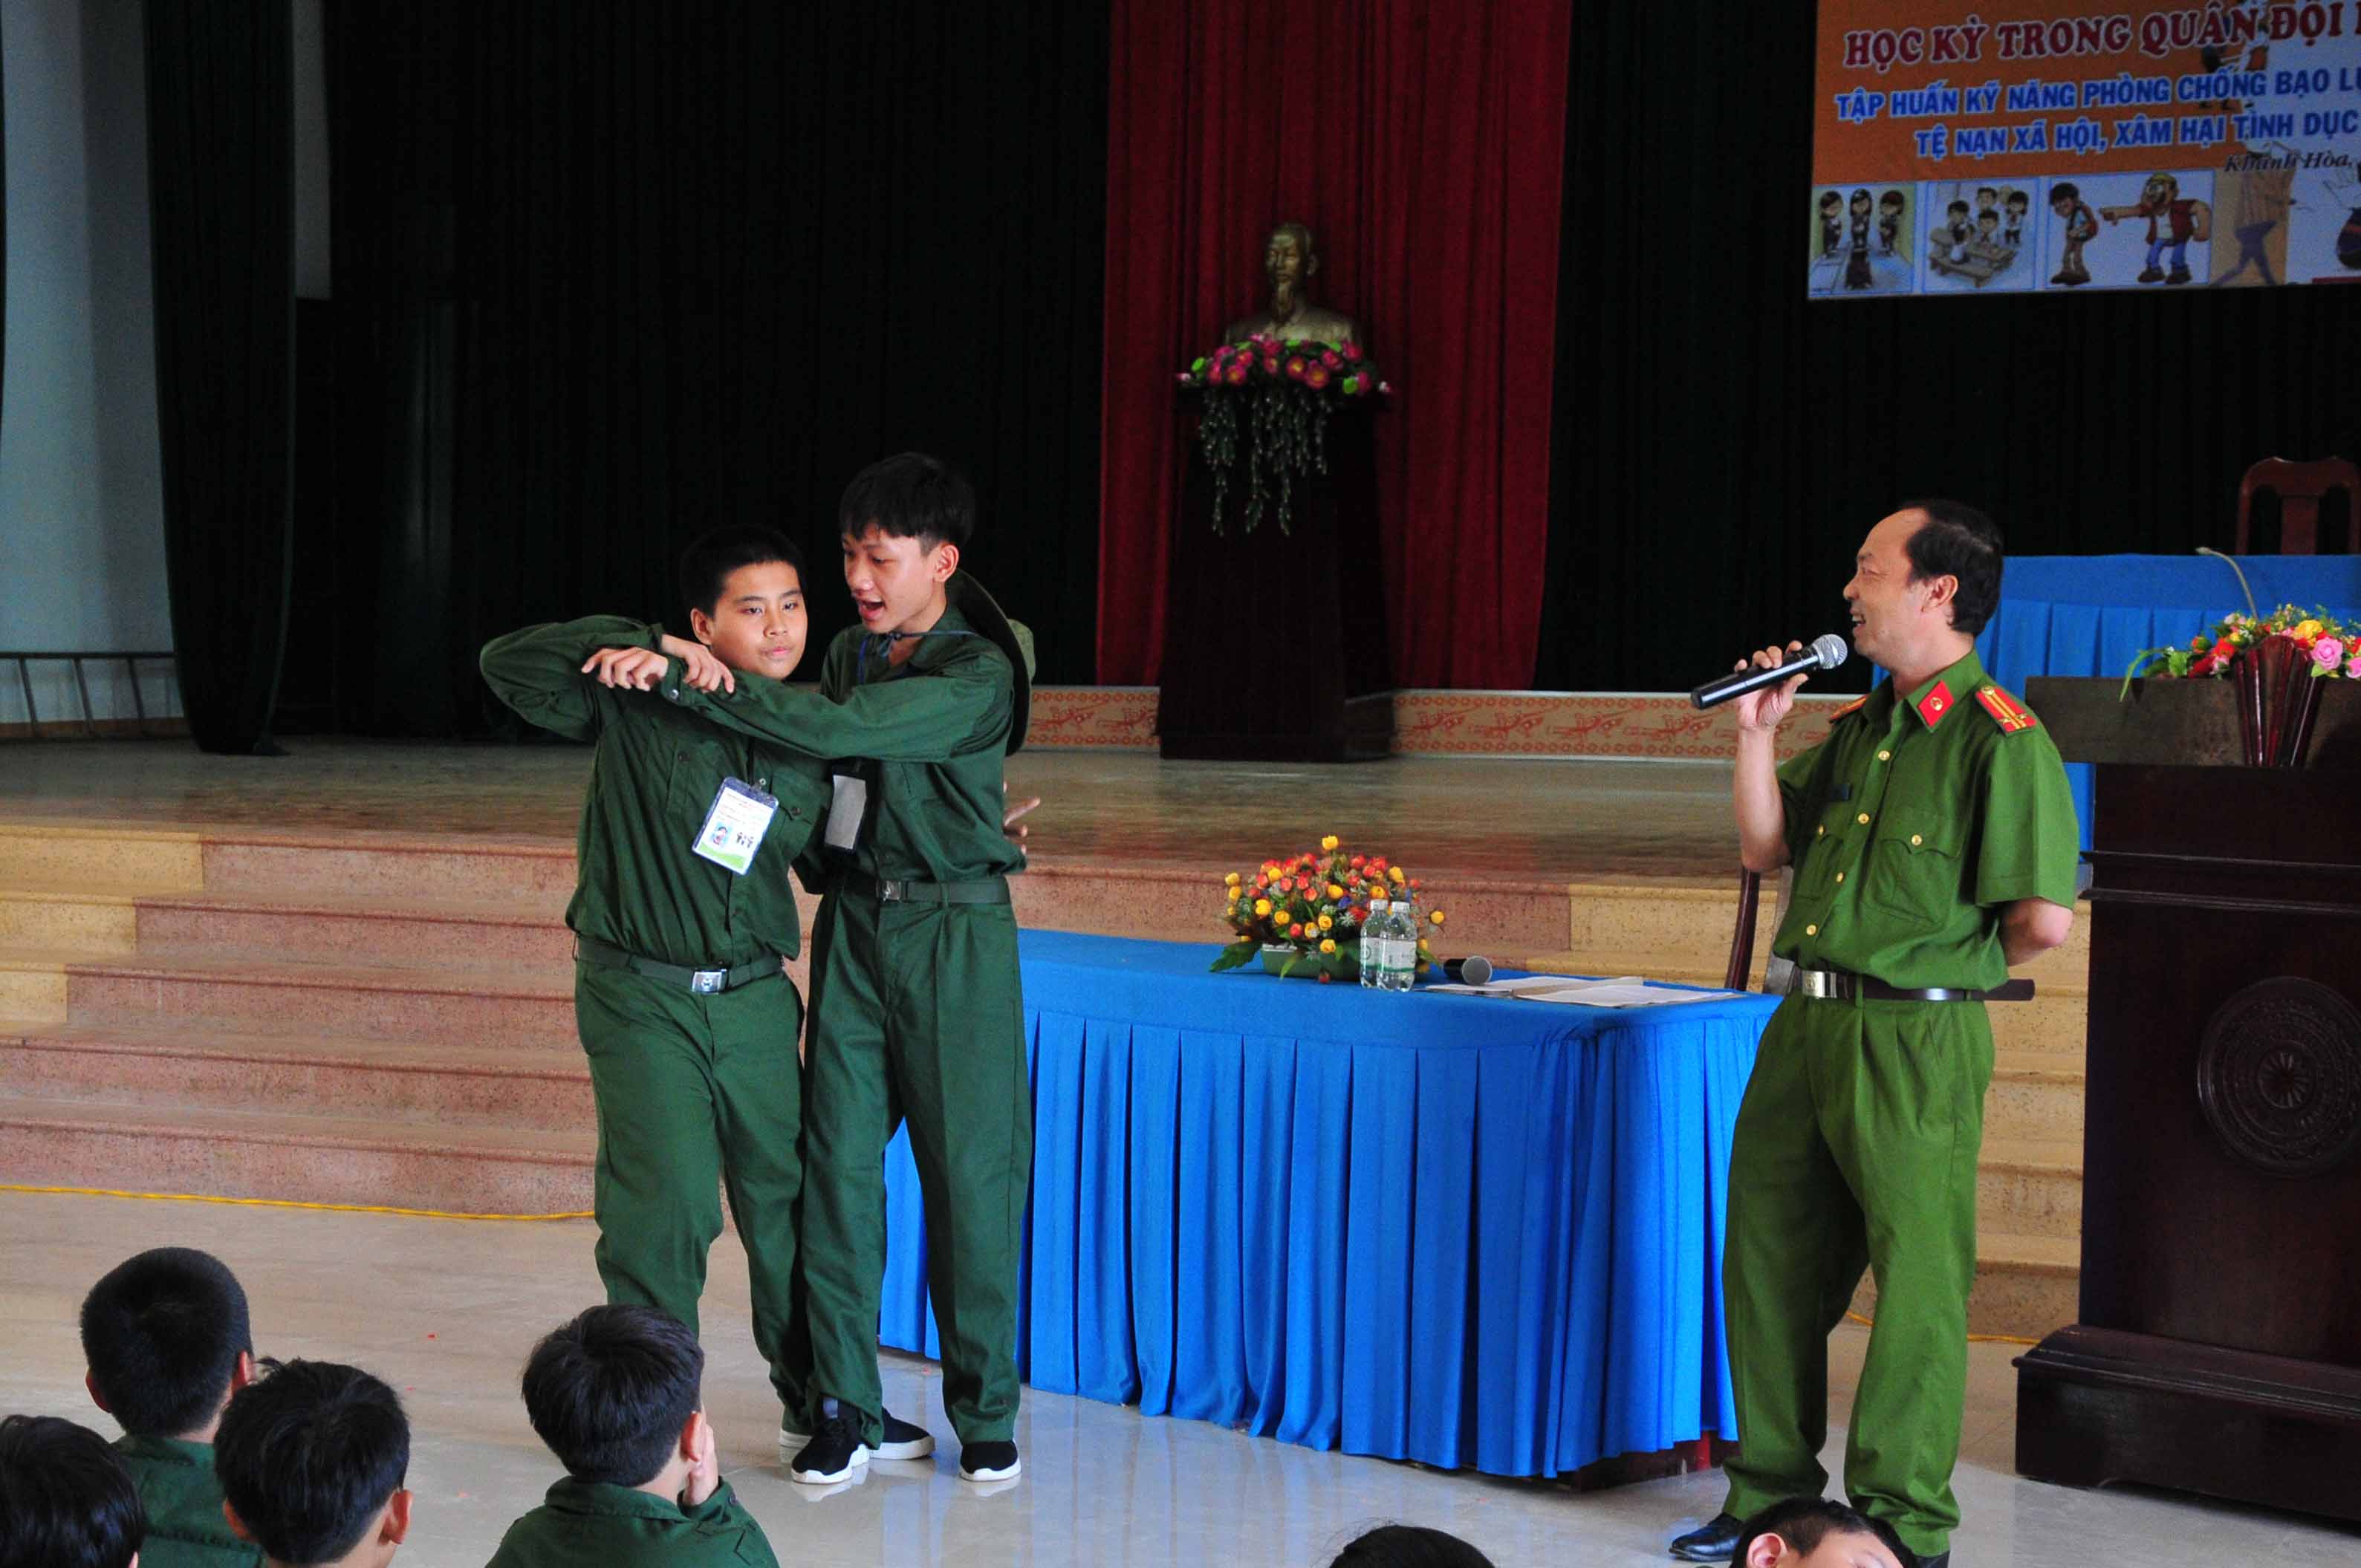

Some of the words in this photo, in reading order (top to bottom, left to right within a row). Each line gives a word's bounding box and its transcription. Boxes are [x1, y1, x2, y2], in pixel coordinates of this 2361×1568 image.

[1844, 27, 1923, 73] HỌC
[1931, 15, 1987, 62] KỲ
[1996, 15, 2131, 58] TRONG
[2140, 0, 2259, 56] QUÂN
[1836, 85, 1885, 124] TẬP
[1890, 79, 1958, 117] HUẤN
[1965, 79, 2001, 113] KỸ
[2007, 79, 2076, 111] NĂNG
[2082, 73, 2171, 108] PHÒNG
[2177, 65, 2265, 102] CHỐNG
[2276, 69, 2330, 98] BẠO
[1915, 123, 1947, 160] TỆ
[1955, 127, 2007, 159] NẠN
[2011, 119, 2048, 153] XÃ
[2054, 117, 2108, 153] HỘI,
[2114, 114, 2174, 148] XÂM
[2178, 115, 2227, 149] HẠI
[2233, 108, 2293, 141] TÌNH
[2304, 109, 2359, 140] DỤC
